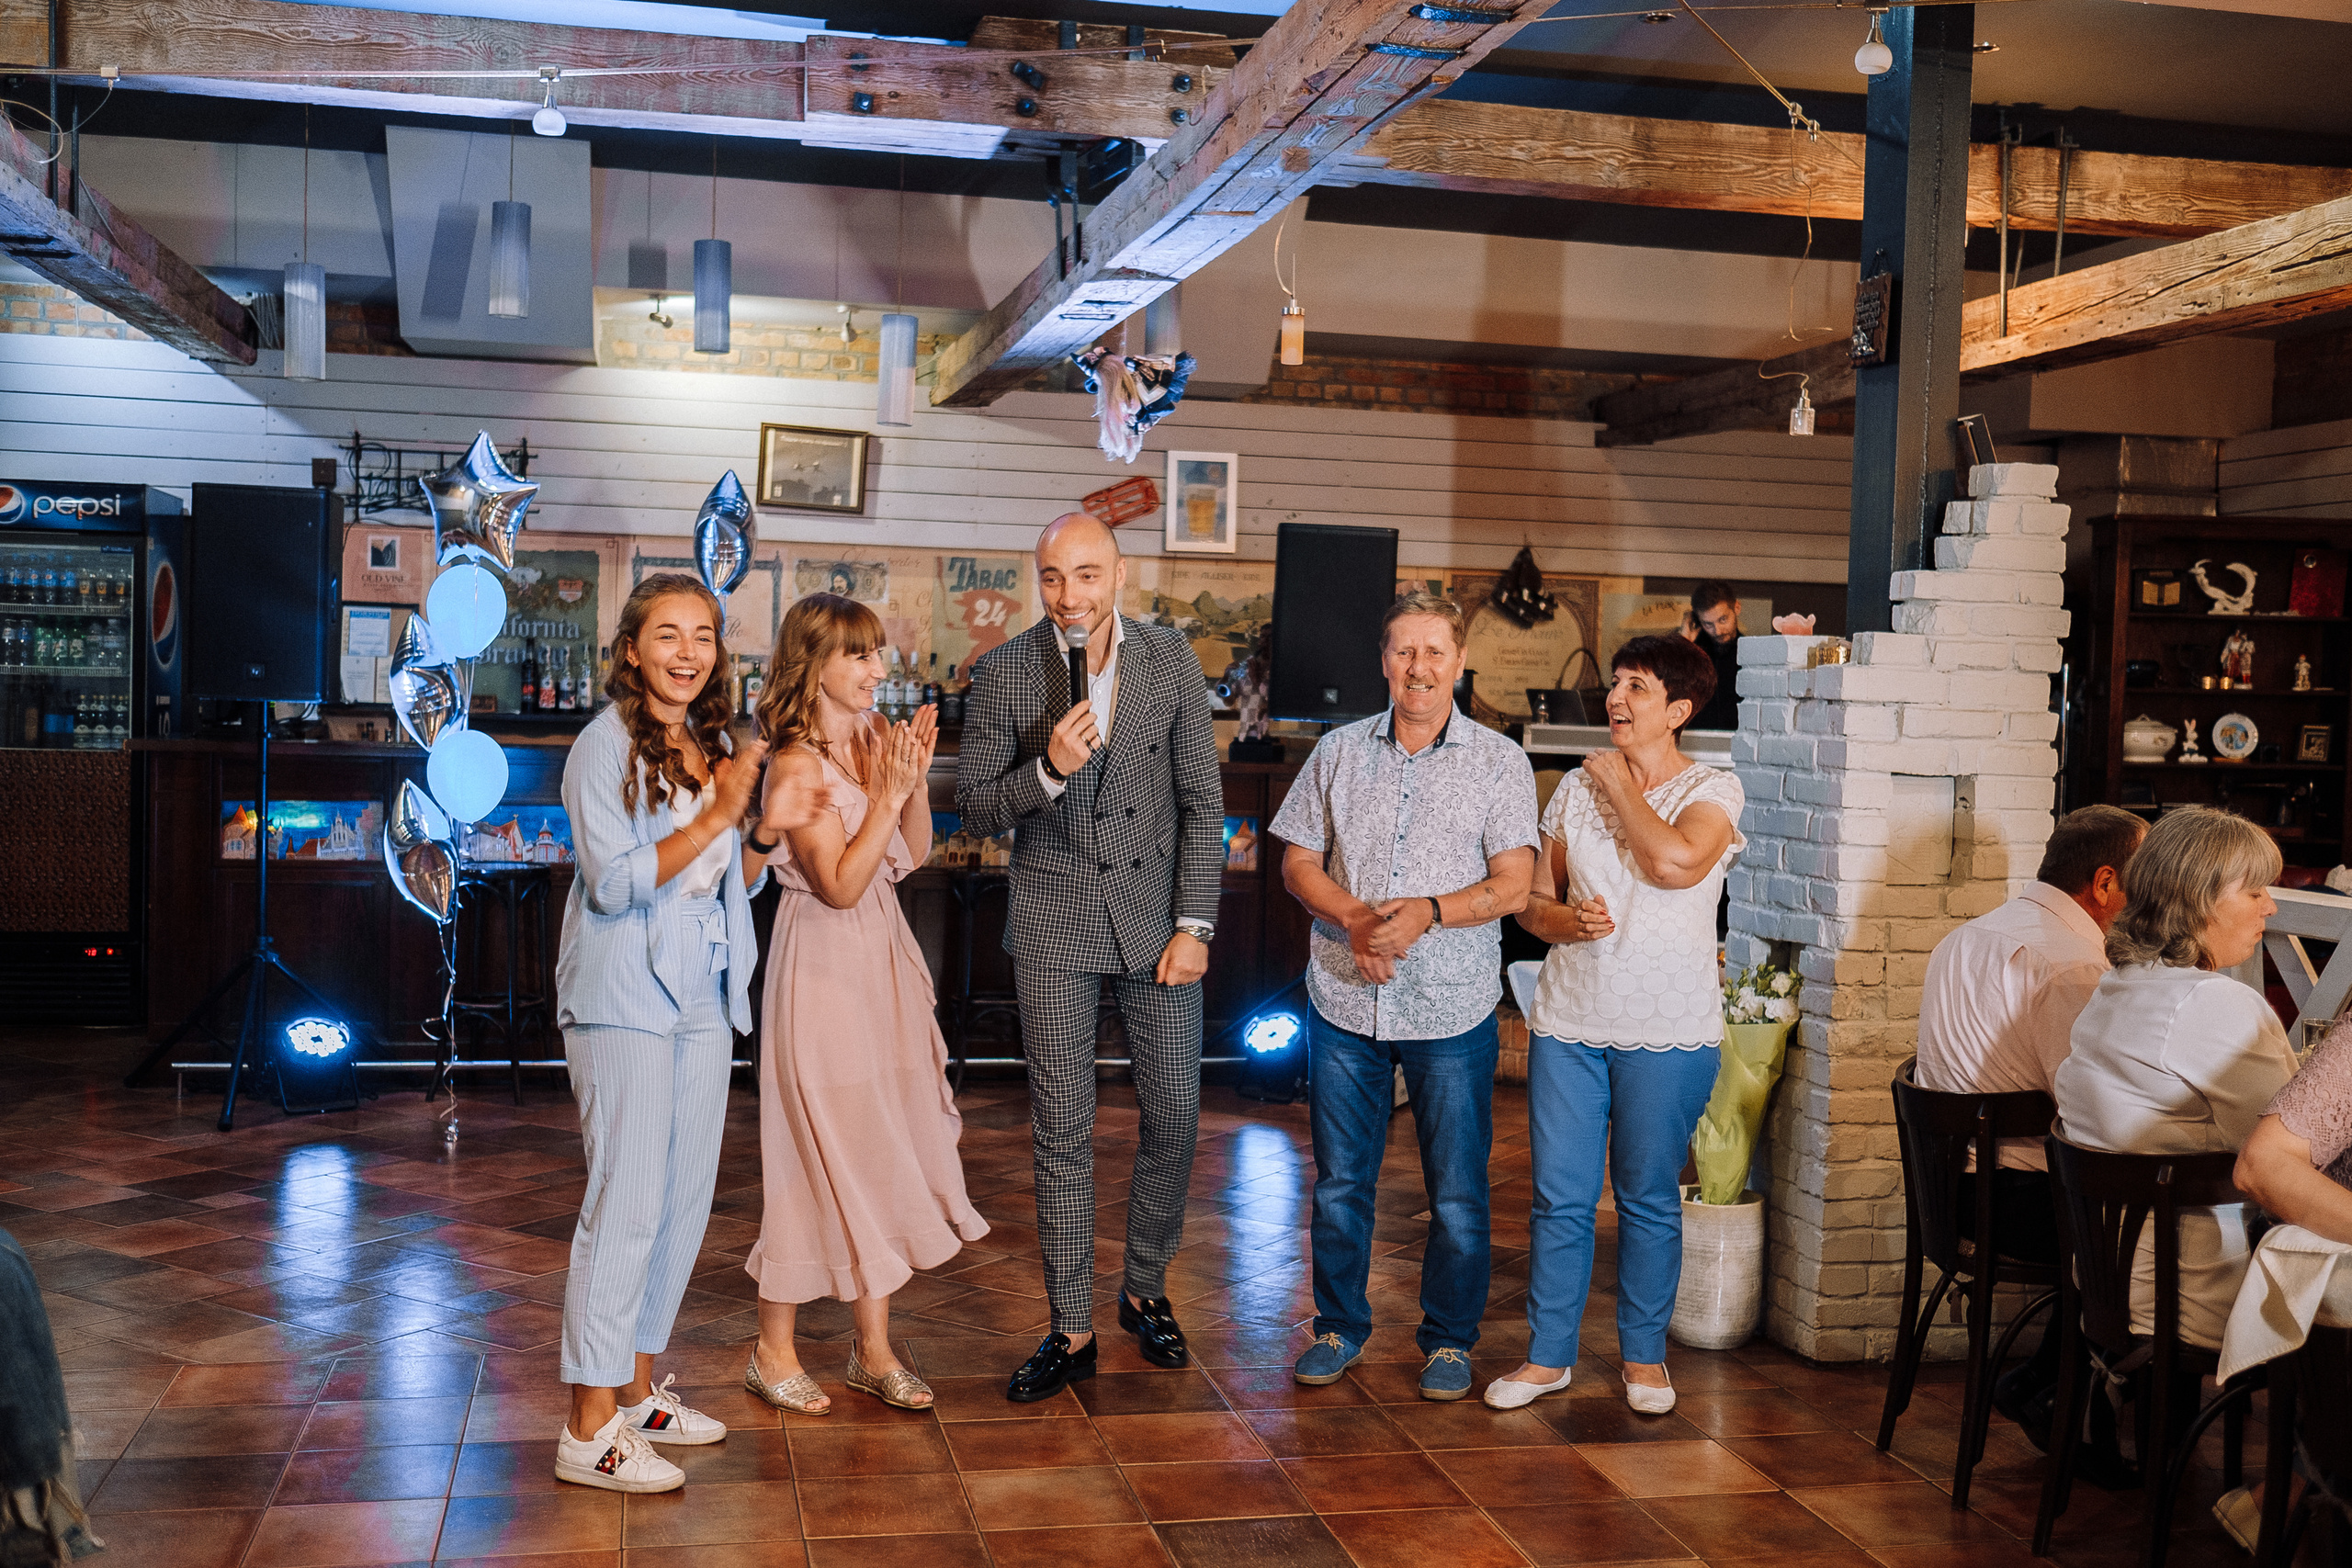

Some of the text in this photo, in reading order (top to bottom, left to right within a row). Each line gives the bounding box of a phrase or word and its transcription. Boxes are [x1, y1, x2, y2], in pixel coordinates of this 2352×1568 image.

[33, 493, 121, 520] pepsi
[948, 557, 1017, 592] TABAC
[503, 613, 581, 639] ifornia
[974, 599, 1008, 627] 24
